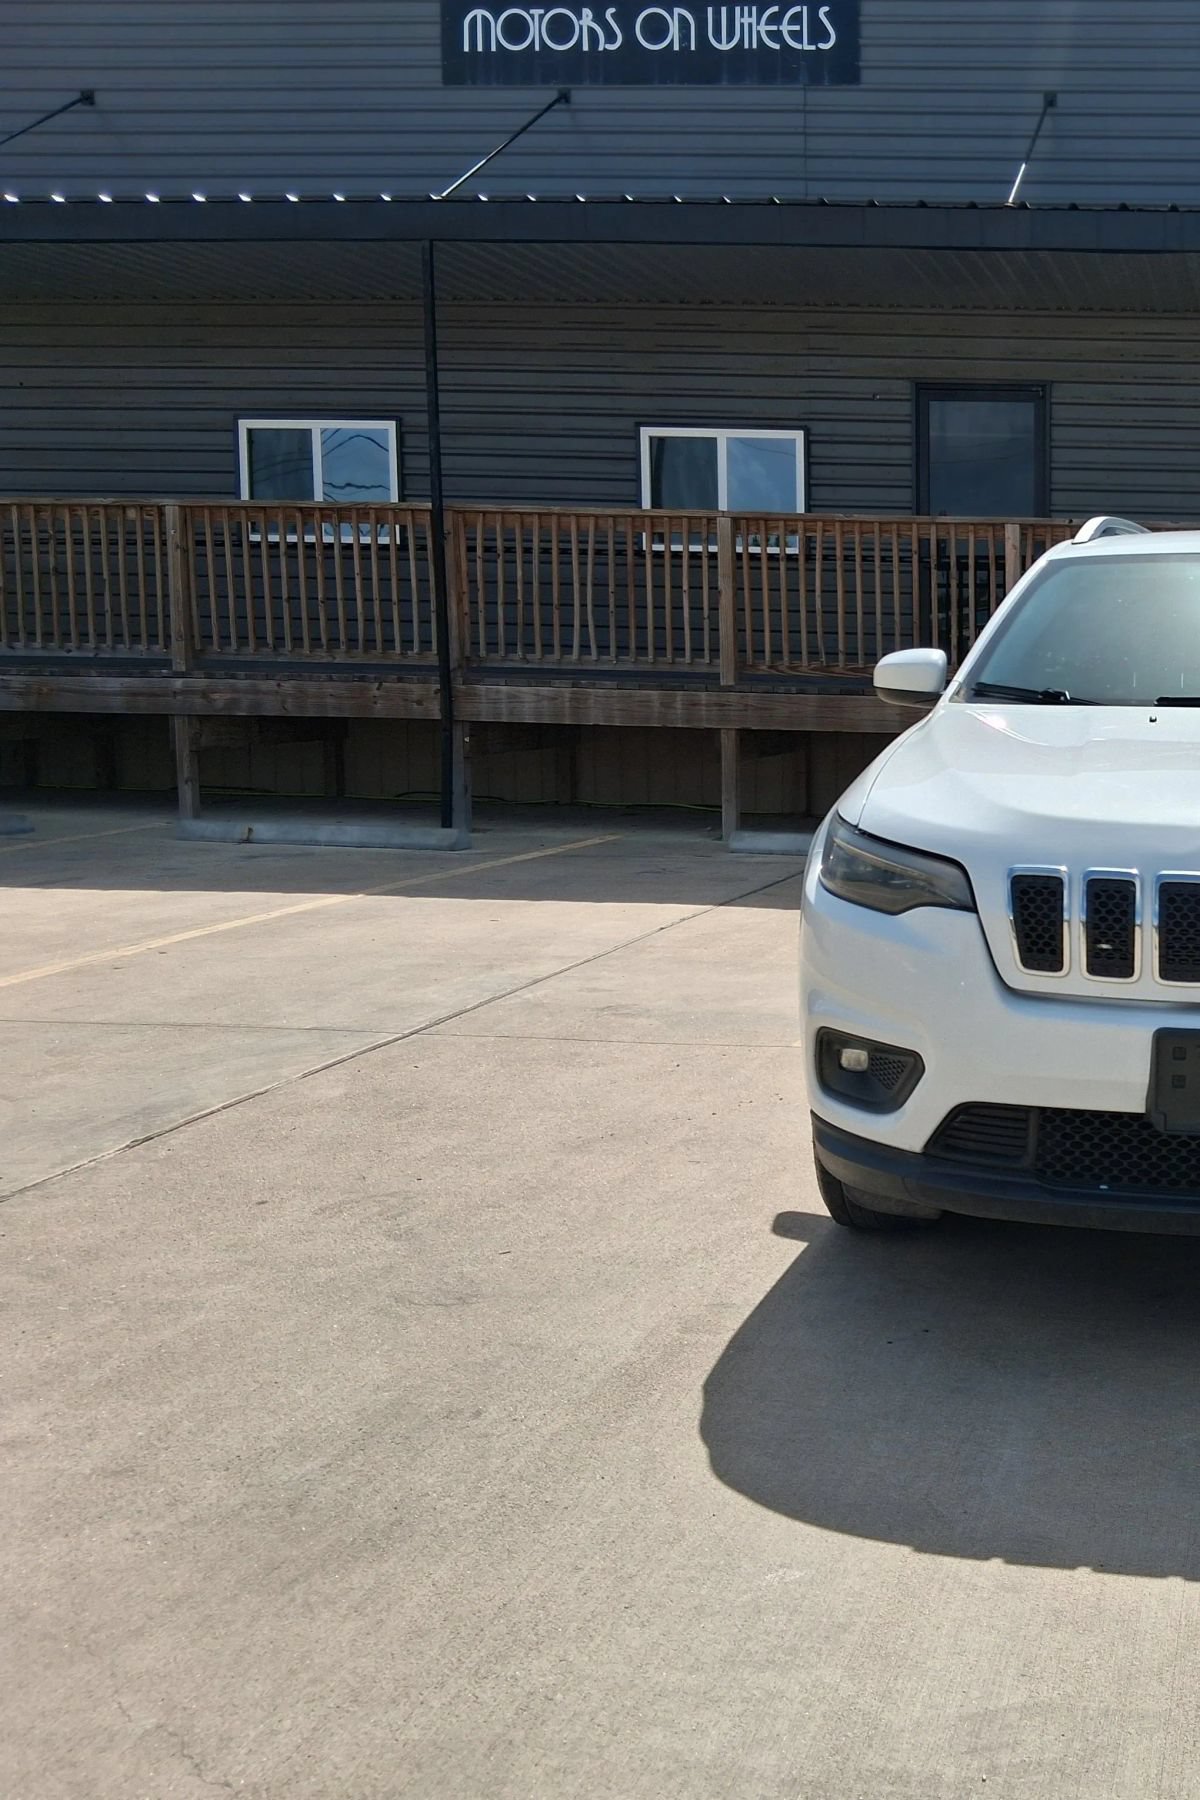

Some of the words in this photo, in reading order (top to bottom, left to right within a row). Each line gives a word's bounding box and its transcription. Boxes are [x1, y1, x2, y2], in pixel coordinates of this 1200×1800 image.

[463, 8, 623, 52] MOTORS
[635, 8, 696, 51] ON
[707, 5, 836, 51] WHEELS
